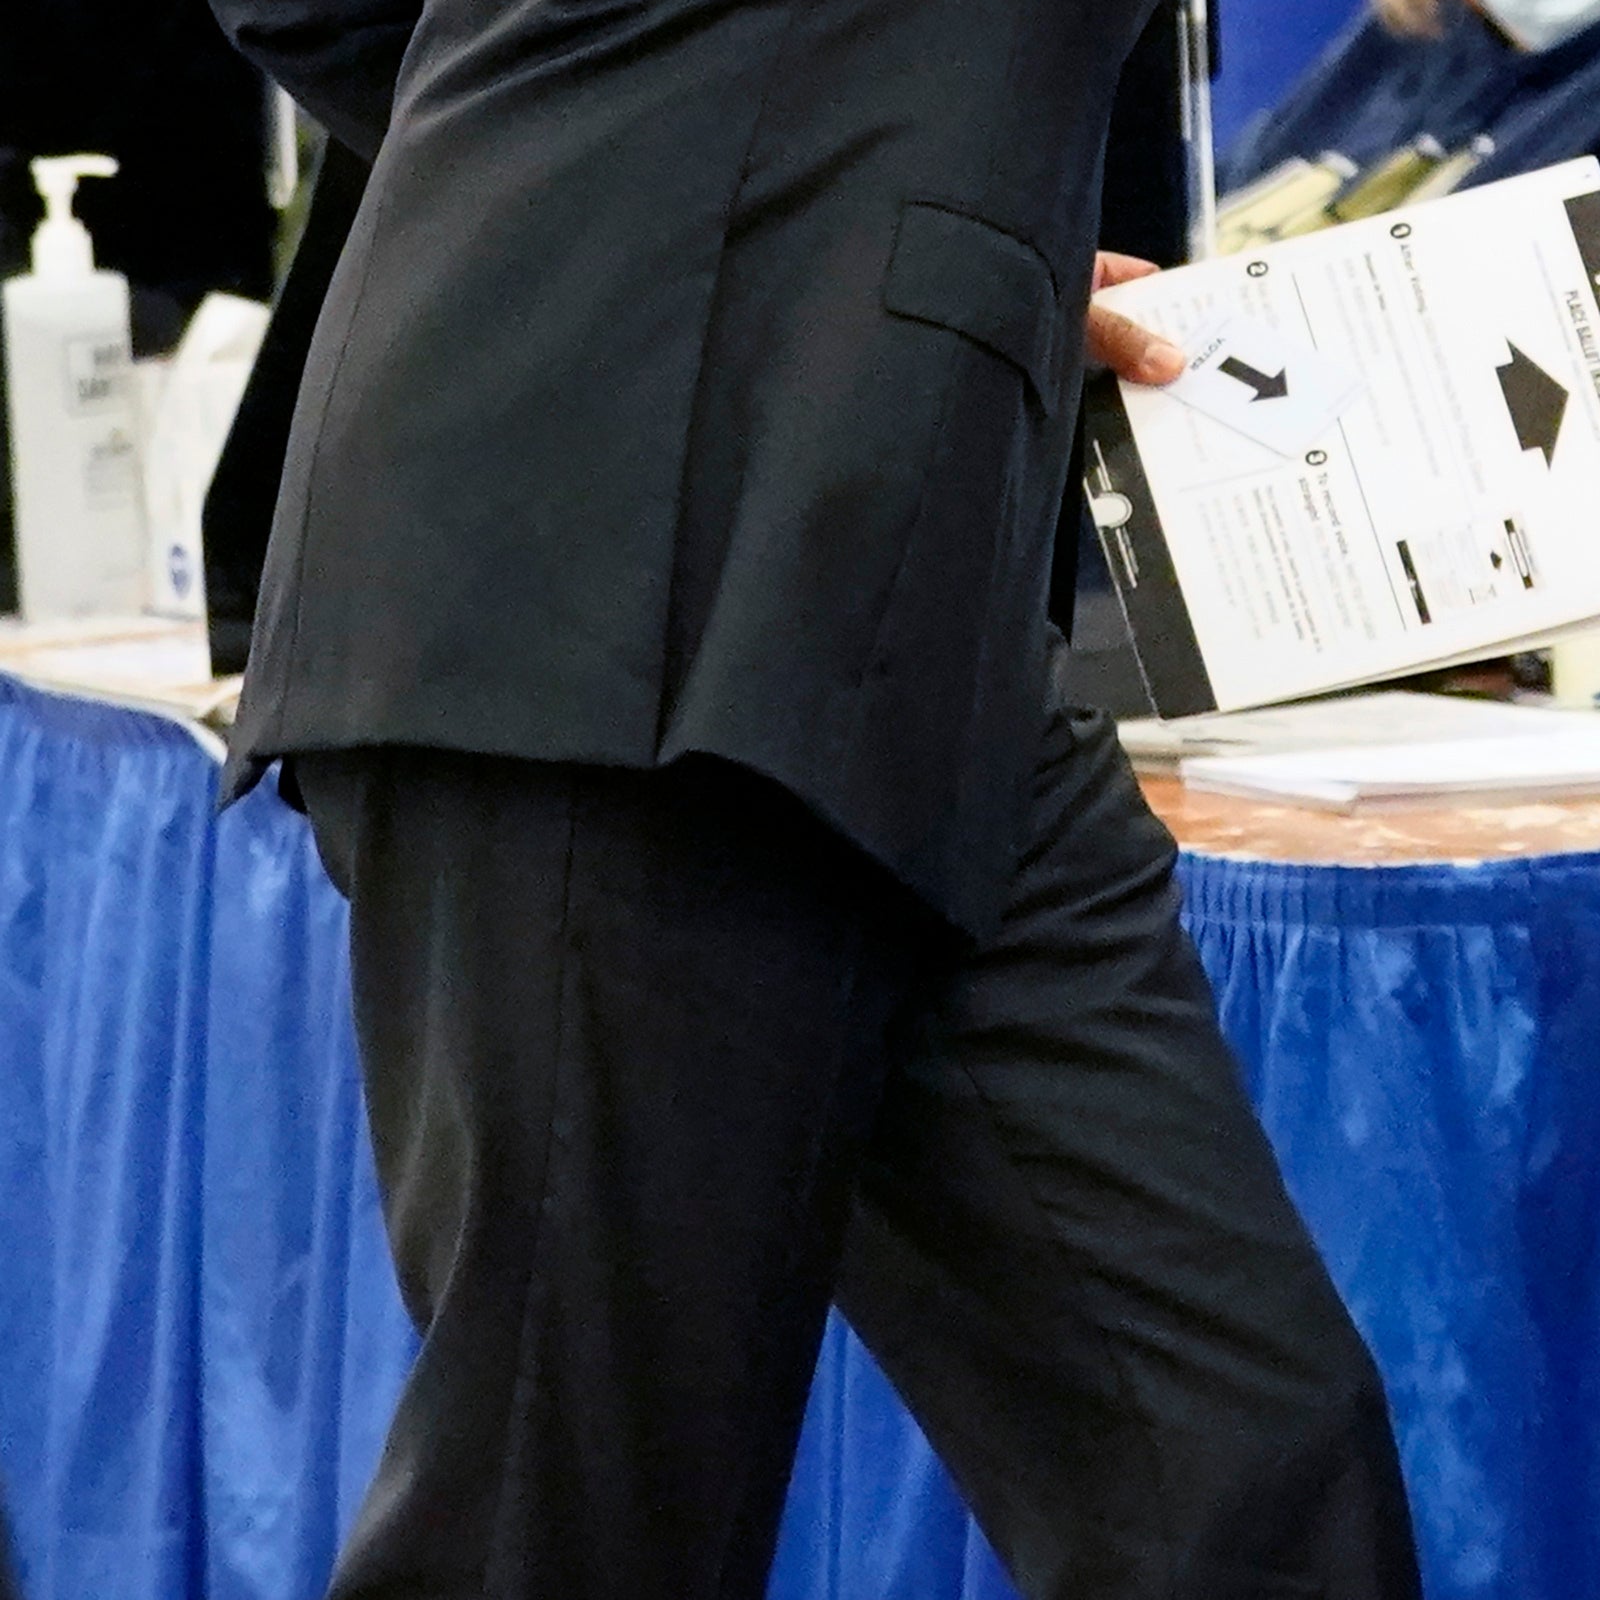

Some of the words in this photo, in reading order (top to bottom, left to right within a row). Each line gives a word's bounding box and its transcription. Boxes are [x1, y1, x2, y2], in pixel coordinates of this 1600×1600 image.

[1246, 260, 1267, 278] 2
[1398, 242, 1416, 272] After
[1562, 287, 1588, 325] PLACE
[1305, 449, 1326, 466] 3
[1315, 471, 1330, 488] To
[1320, 488, 1342, 528] record
